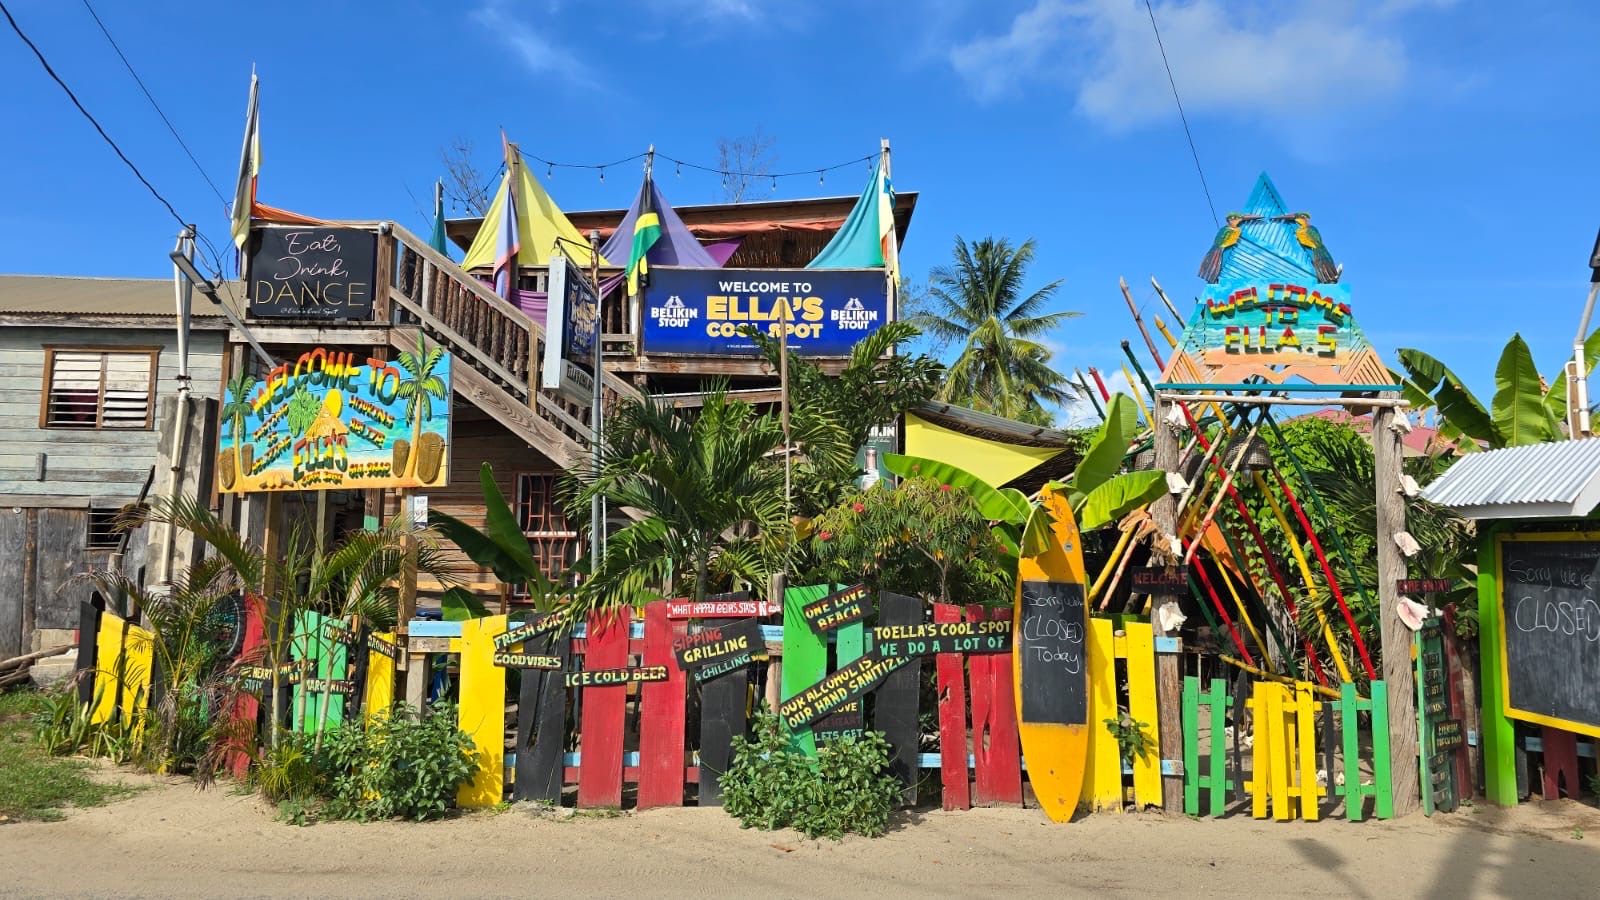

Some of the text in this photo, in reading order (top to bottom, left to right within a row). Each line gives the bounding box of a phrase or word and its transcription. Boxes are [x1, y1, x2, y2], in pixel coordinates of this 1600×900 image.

[285, 231, 341, 255] Eat,
[273, 256, 349, 280] Drink,
[255, 280, 367, 306] DANCE
[719, 281, 812, 293] WELCOME TO
[651, 306, 698, 318] BELIKIN
[706, 296, 824, 321] ELLA'S
[830, 309, 878, 320] BELIKIN
[1207, 284, 1351, 326] WELCOME
[1262, 306, 1298, 328] TO
[658, 318, 690, 328] STOUT
[768, 323, 824, 339] SPOT
[838, 320, 870, 330] STOUT
[251, 347, 400, 422] WELCOME TO
[1133, 572, 1188, 585] WELCOME
[1508, 560, 1552, 593] Sorry
[671, 603, 691, 615] WHAT
[804, 600, 831, 620] ONE
[833, 586, 867, 609] LOVE
[817, 603, 861, 630] BEACH
[940, 621, 974, 636] COOL
[978, 620, 1012, 634] SPOT
[1024, 613, 1084, 644] CLOSED
[1515, 596, 1600, 642] CLOSED
[493, 623, 536, 649] FRESH
[673, 627, 722, 652] SIPPING
[880, 635, 1005, 656] WE DO A LOT OF
[683, 635, 748, 663] GRILLING
[1029, 645, 1080, 674] Today
[565, 666, 667, 687] ICE COLD BEER
[702, 653, 751, 679] CHILLING
[305, 679, 355, 693] MARGRITAS
[781, 697, 806, 717] OUR
[788, 706, 814, 728] OUR
[814, 687, 848, 714] HAND
[832, 702, 858, 713] OVE
[842, 729, 863, 739] GET
